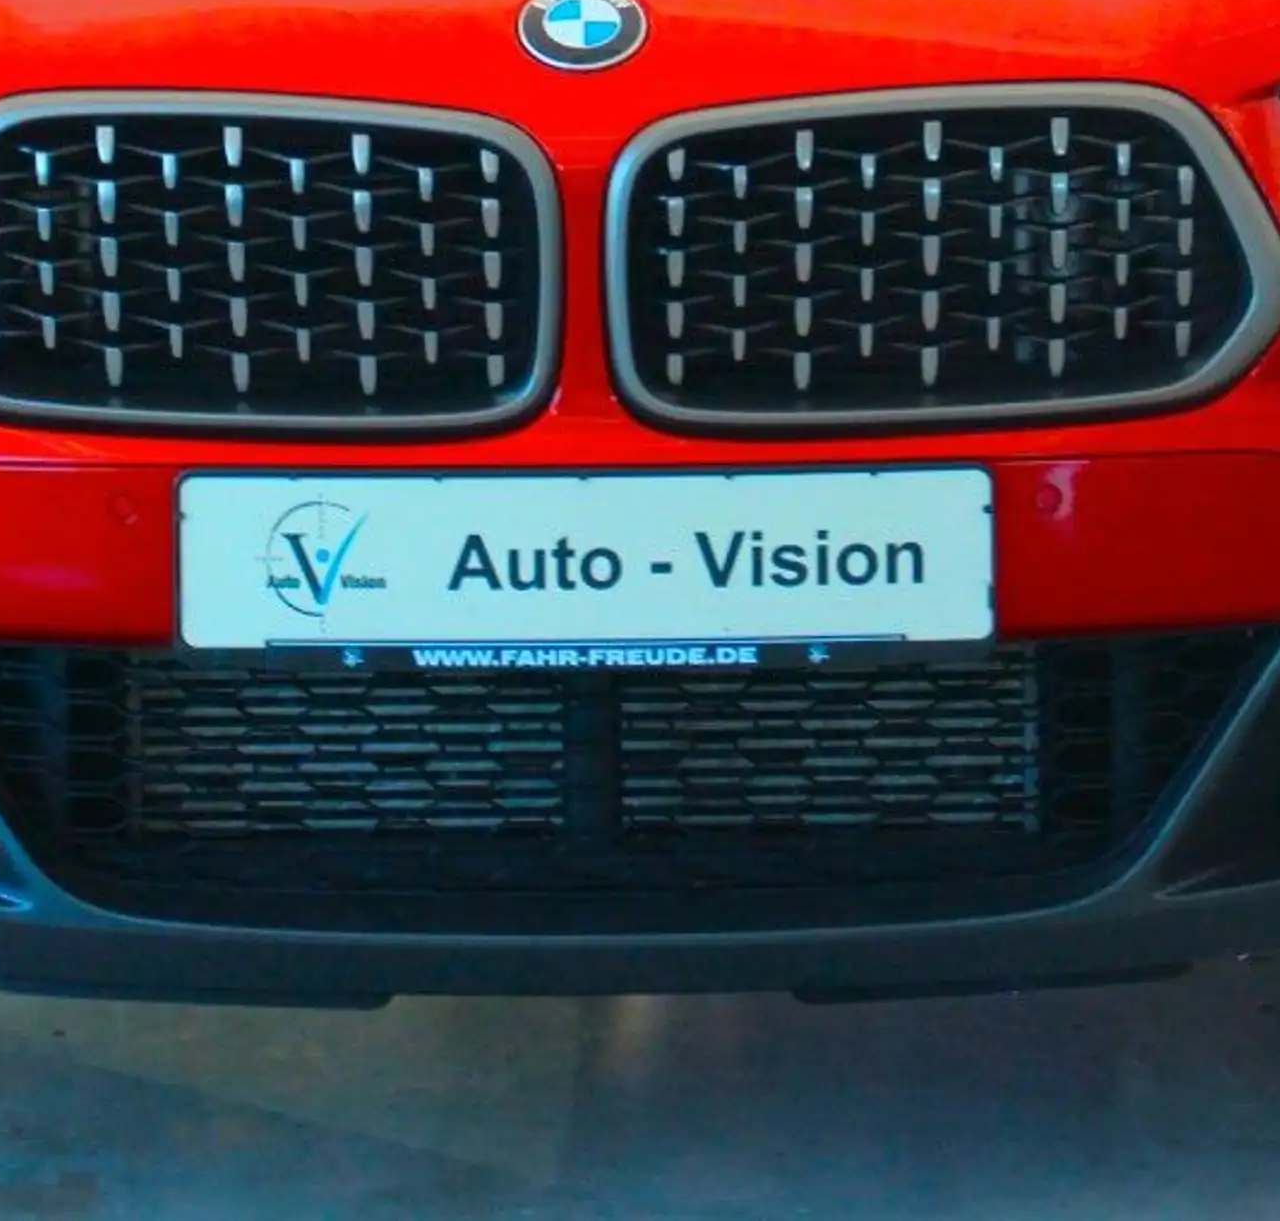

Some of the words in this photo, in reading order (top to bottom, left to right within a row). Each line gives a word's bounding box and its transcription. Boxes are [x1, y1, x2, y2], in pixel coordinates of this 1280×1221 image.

[448, 533, 623, 592] Auto
[650, 560, 673, 575] -
[694, 529, 925, 589] Vision
[266, 574, 301, 589] Auto
[340, 573, 387, 589] Vision
[412, 646, 758, 667] WWW.FAHR-FREUDE.DE
